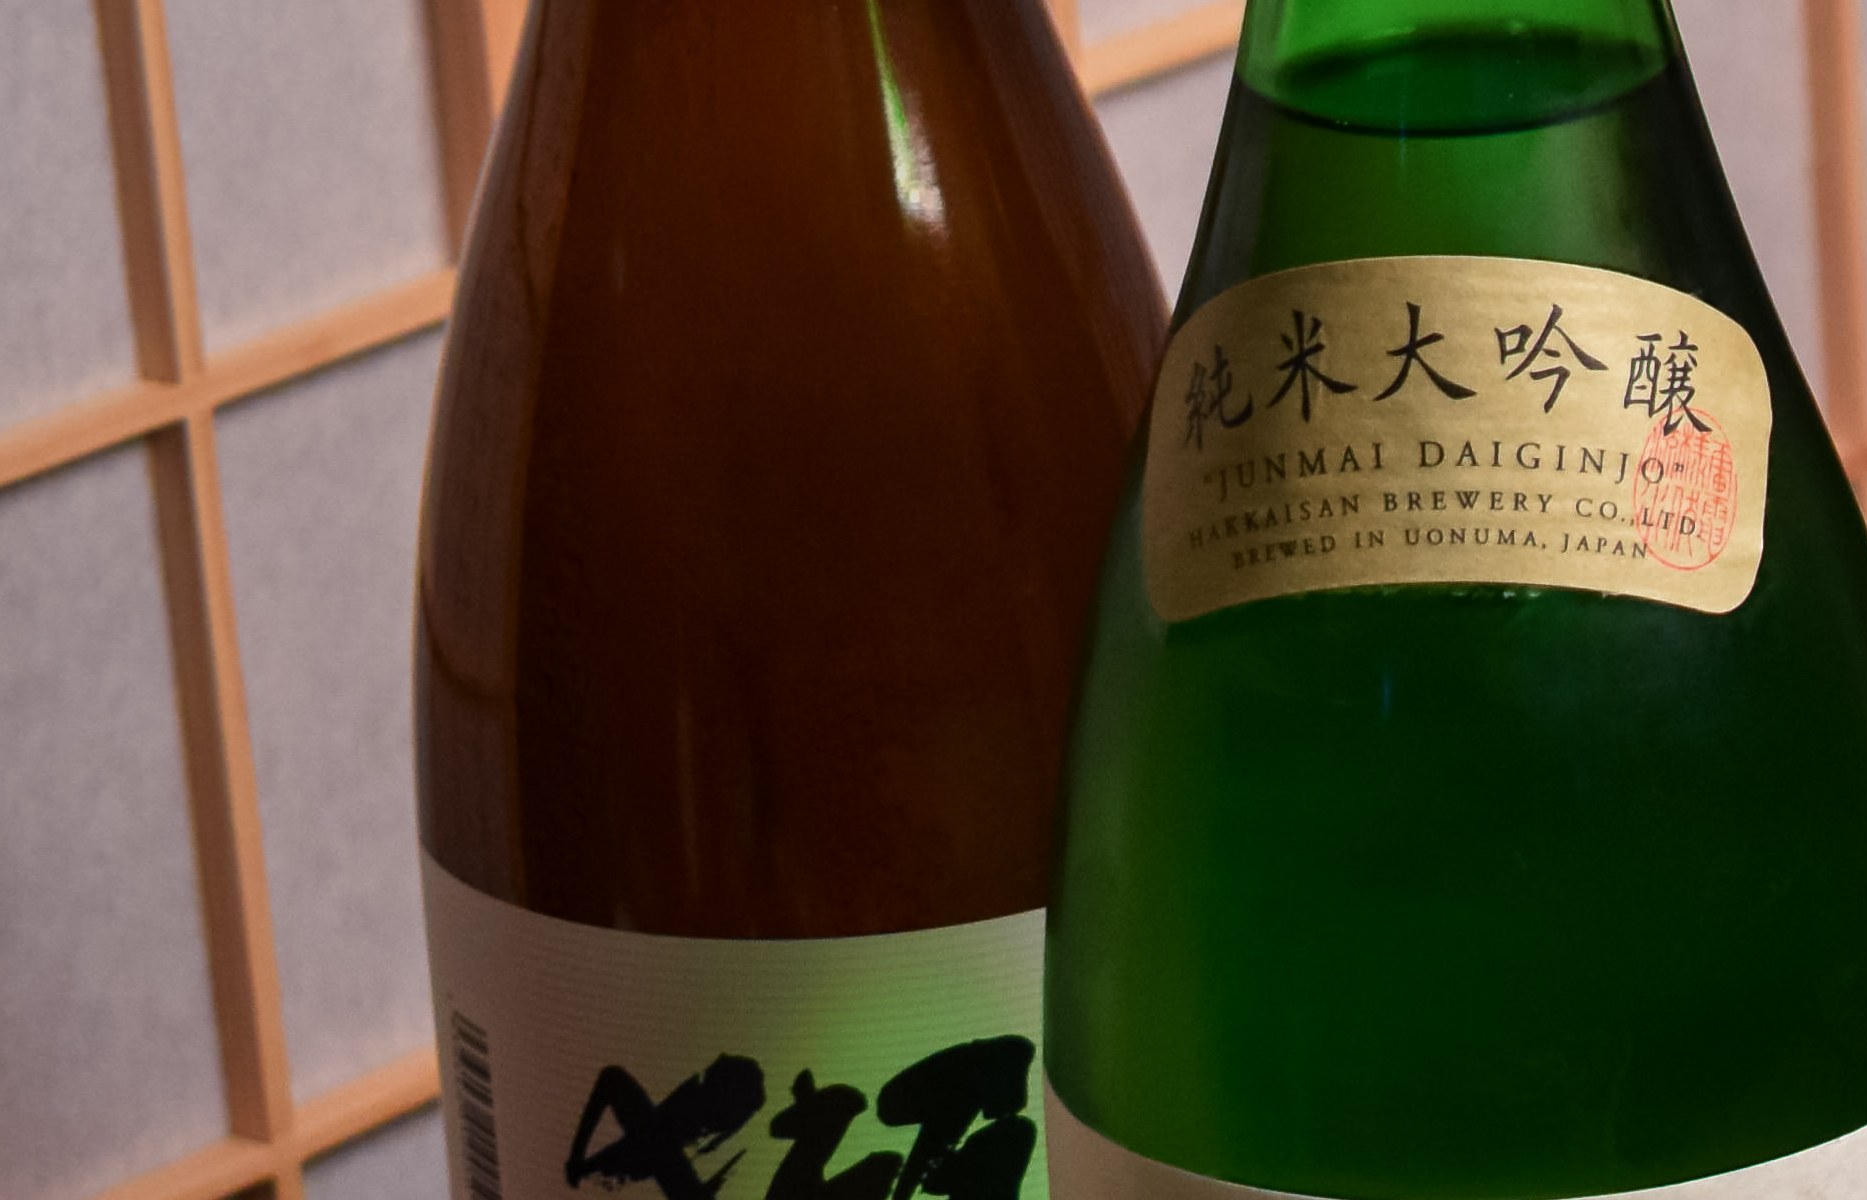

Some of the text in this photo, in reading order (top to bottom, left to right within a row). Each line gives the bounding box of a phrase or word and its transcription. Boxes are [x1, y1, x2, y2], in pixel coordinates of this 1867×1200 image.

[1182, 302, 1713, 452] 純米大吟醸
[1190, 494, 1360, 549] HAKKAISAN
[1384, 490, 1552, 513] BREWERY
[1231, 527, 1648, 570] BREWED IN UONUMA, JAPAN
